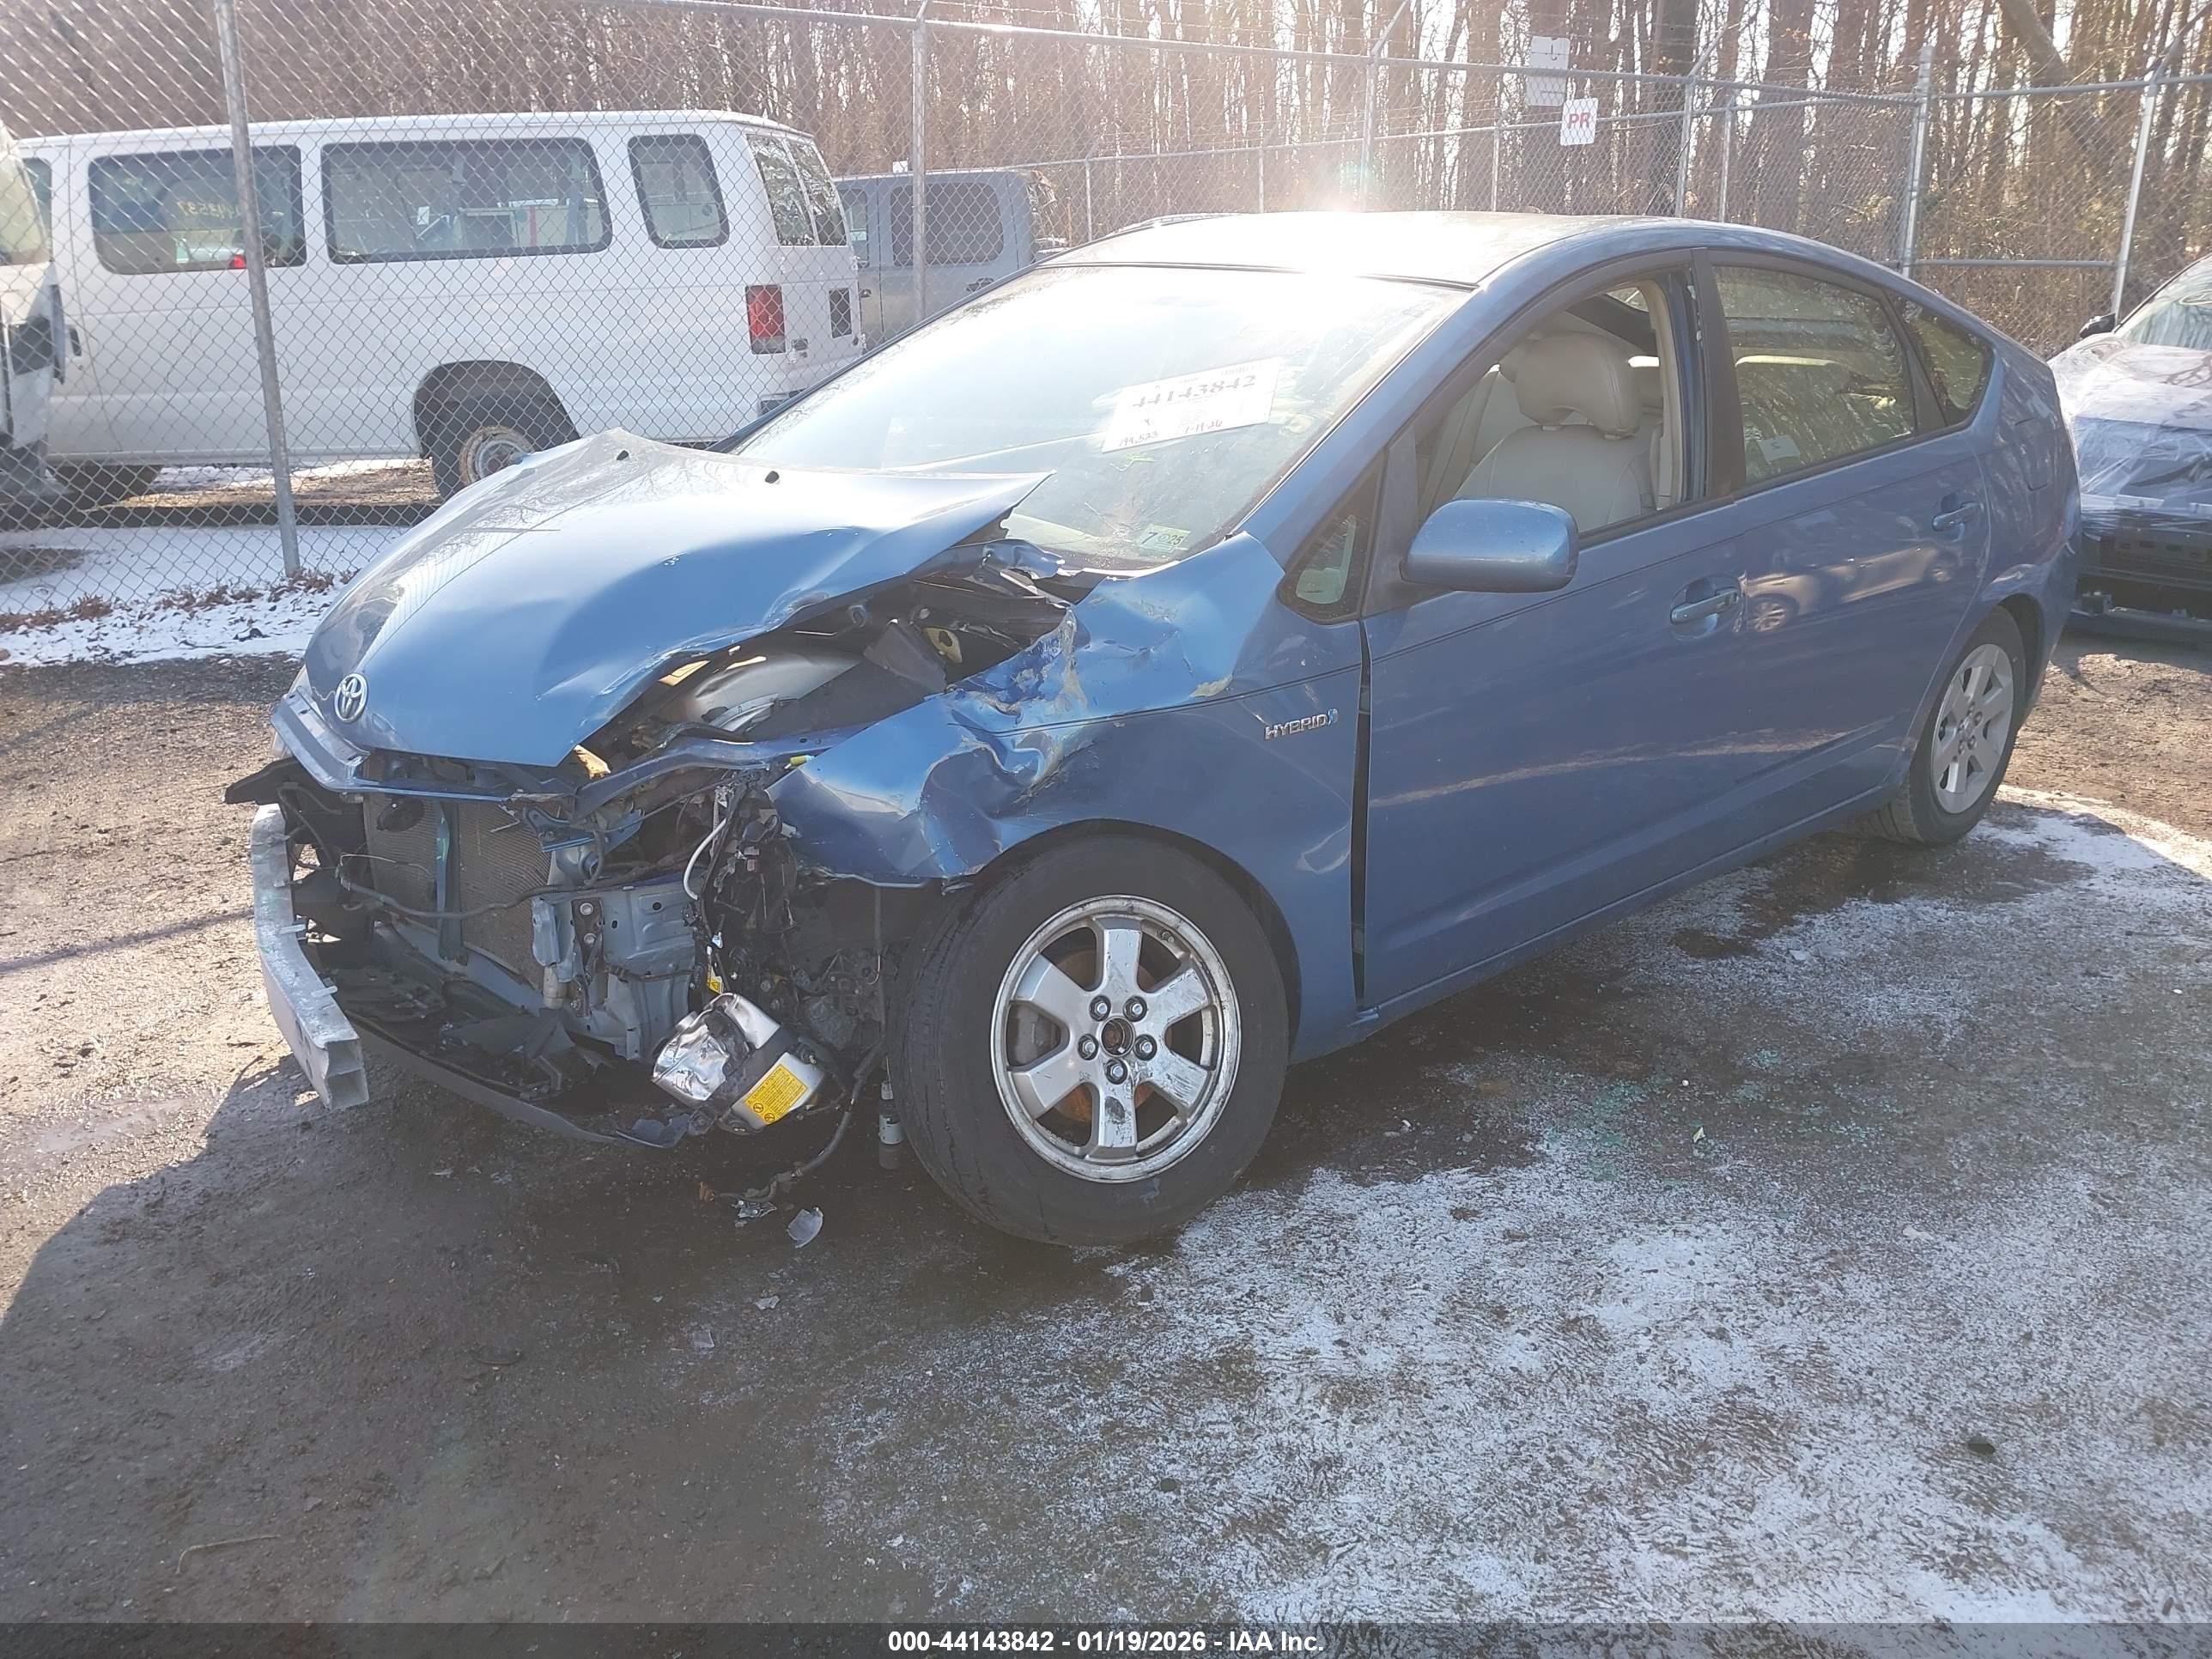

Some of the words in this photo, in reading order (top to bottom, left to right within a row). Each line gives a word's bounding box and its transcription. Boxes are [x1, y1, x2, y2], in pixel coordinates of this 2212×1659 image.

[1568, 112, 1591, 128] PR
[1168, 534, 1184, 545] 25
[1265, 714, 1328, 740] HYBRID
